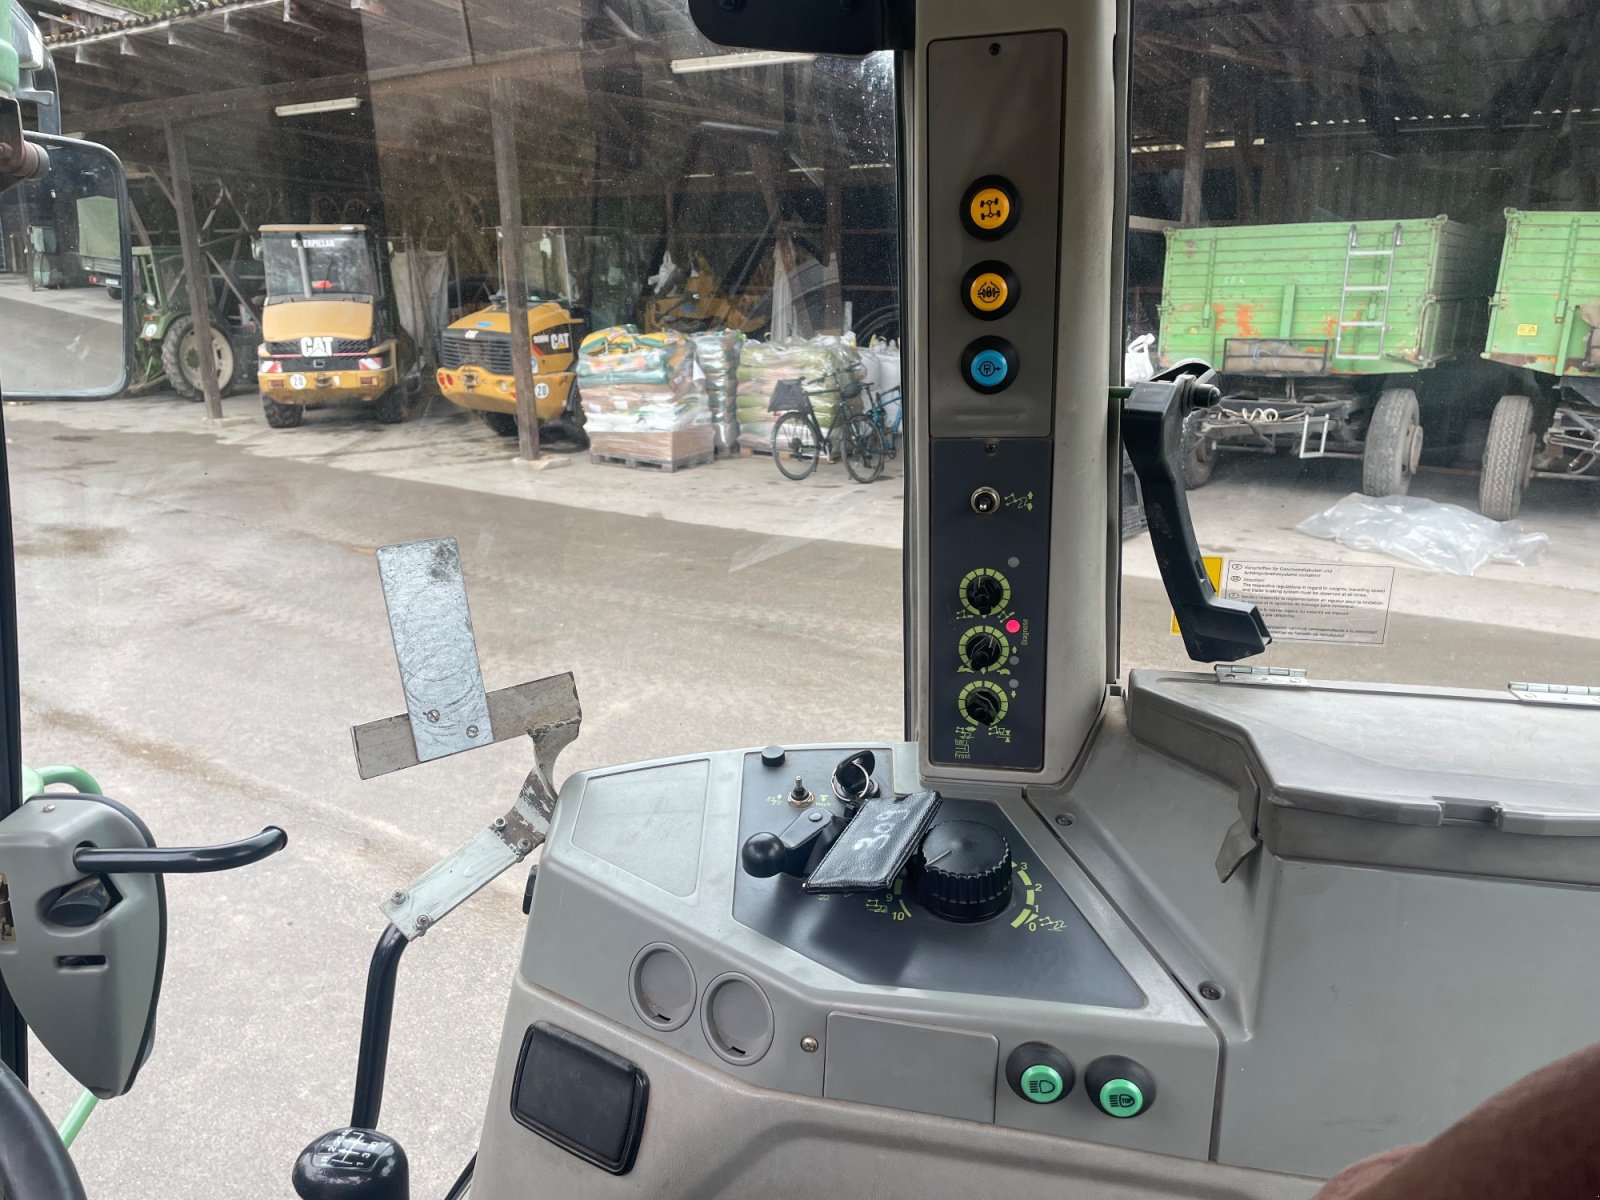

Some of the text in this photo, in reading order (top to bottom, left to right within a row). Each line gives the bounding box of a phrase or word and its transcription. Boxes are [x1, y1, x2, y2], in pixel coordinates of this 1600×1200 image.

[550, 332, 570, 350] CAT
[300, 336, 334, 358] CAT
[293, 376, 304, 386] 20
[536, 385, 547, 396] 20
[1034, 884, 1042, 892] 2
[886, 894, 893, 902] 9
[1034, 904, 1039, 912] 1
[892, 912, 904, 920] 10
[1028, 922, 1036, 932] 0
